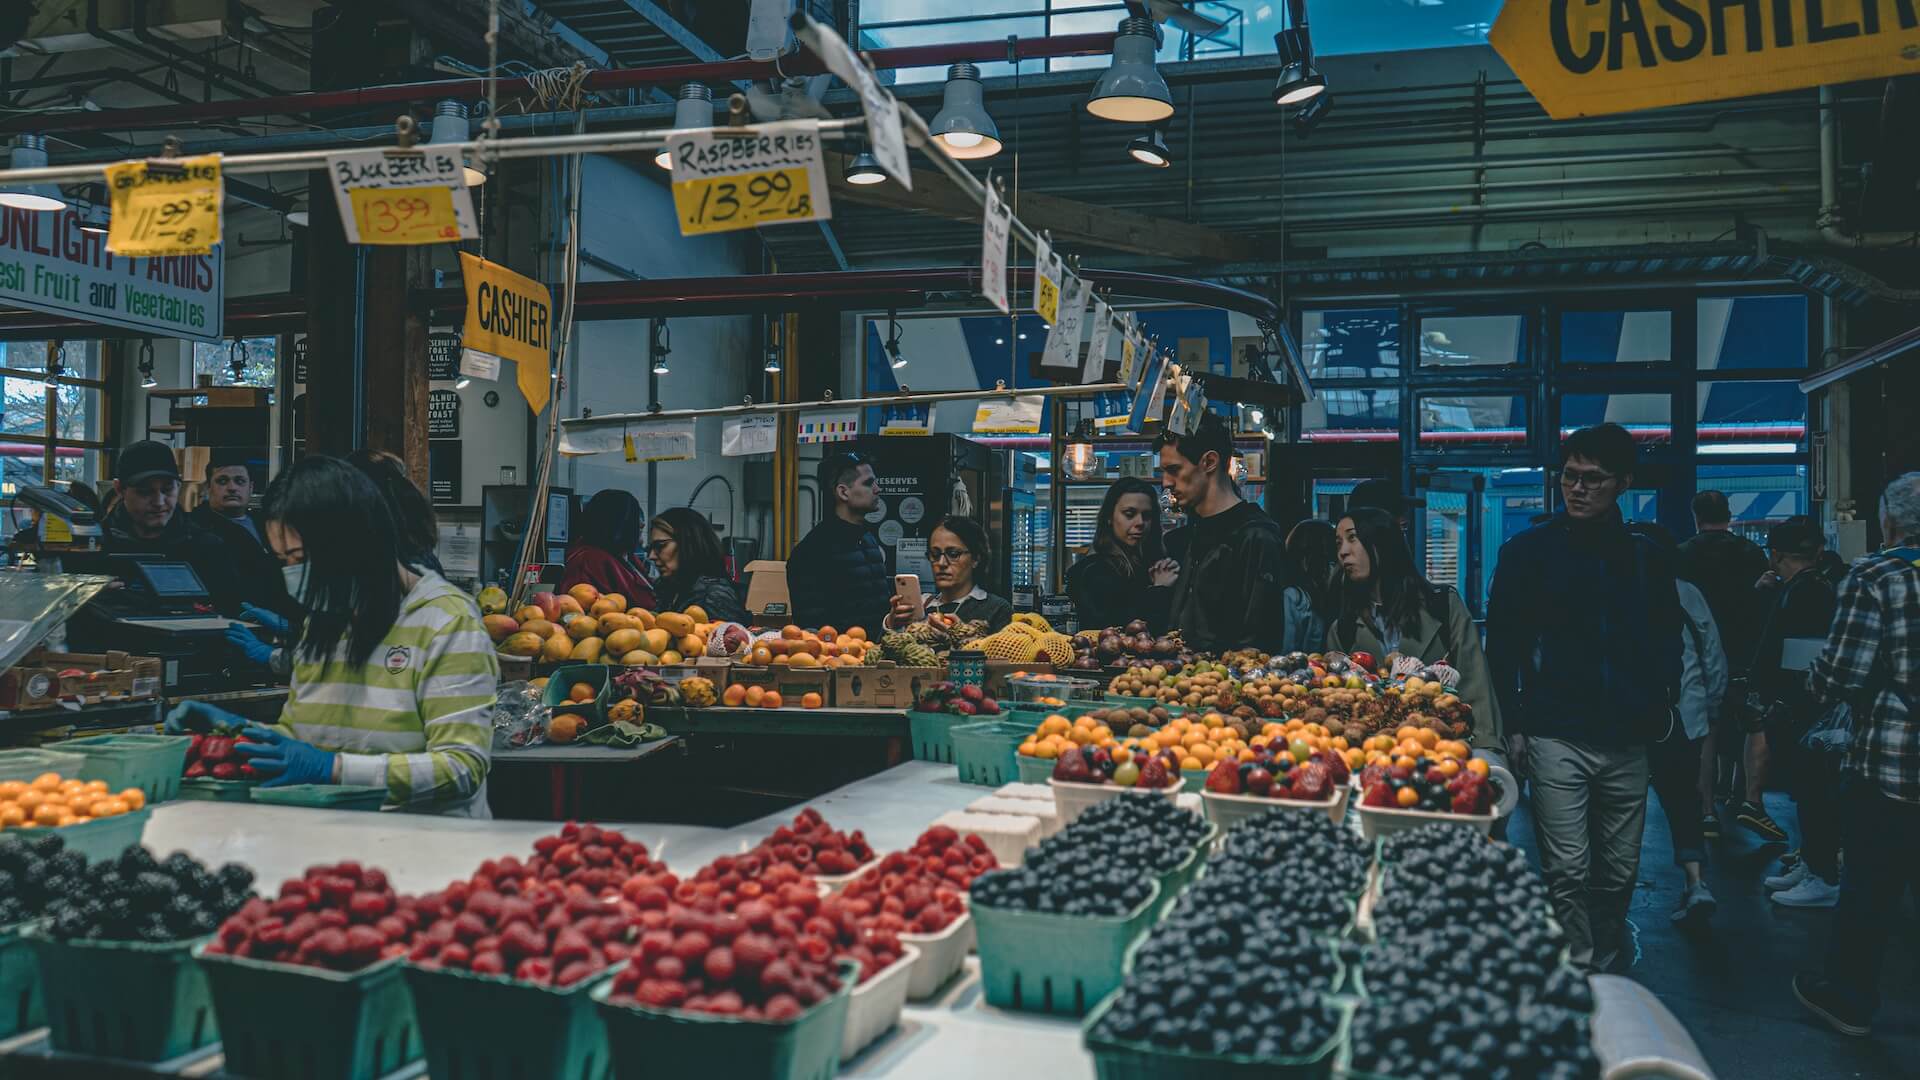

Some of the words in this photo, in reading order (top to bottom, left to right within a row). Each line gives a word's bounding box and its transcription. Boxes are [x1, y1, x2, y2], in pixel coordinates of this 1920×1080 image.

[678, 135, 814, 170] RASPBERRIES
[34, 263, 80, 304] Fruit
[89, 281, 116, 310] and
[125, 284, 205, 329] Vegetables
[478, 280, 548, 351] CASHIER
[429, 402, 457, 410] UTTER
